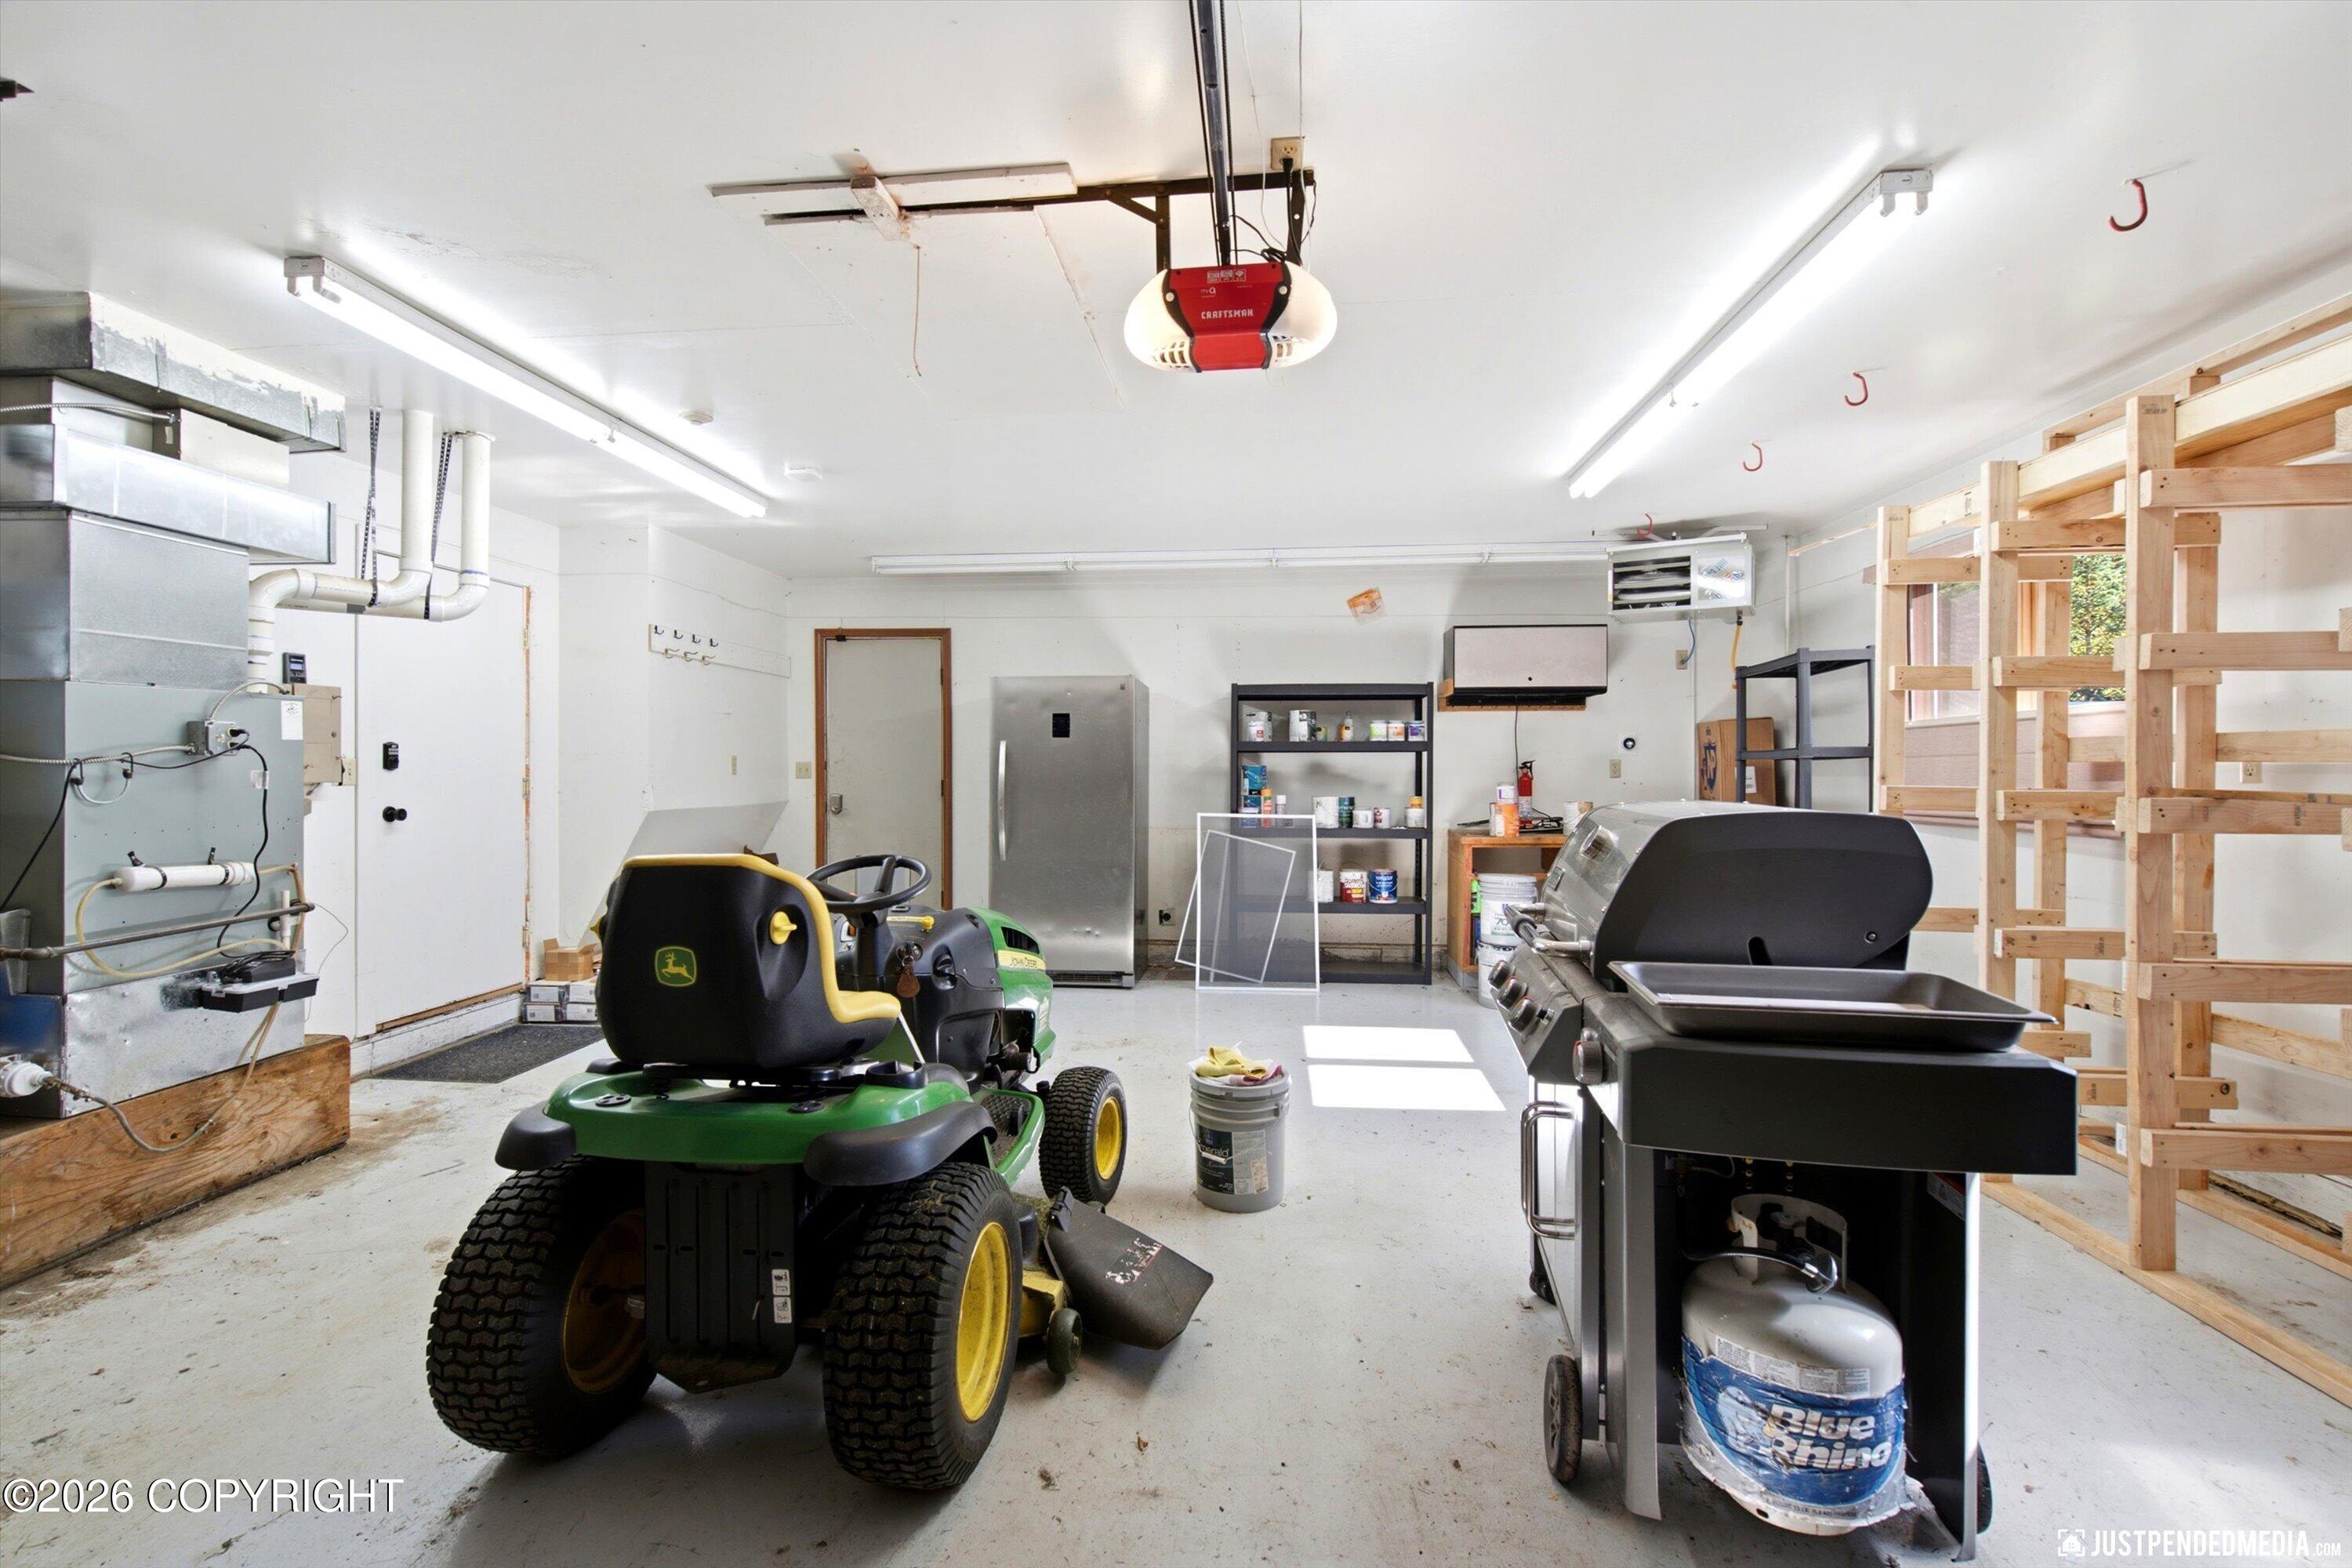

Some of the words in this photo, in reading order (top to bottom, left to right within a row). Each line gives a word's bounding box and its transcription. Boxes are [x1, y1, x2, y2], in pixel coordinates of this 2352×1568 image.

[1201, 309, 1254, 319] CRAFTSMAN
[1770, 1403, 1876, 1441] Blue
[1772, 1432, 1892, 1471] Rhino
